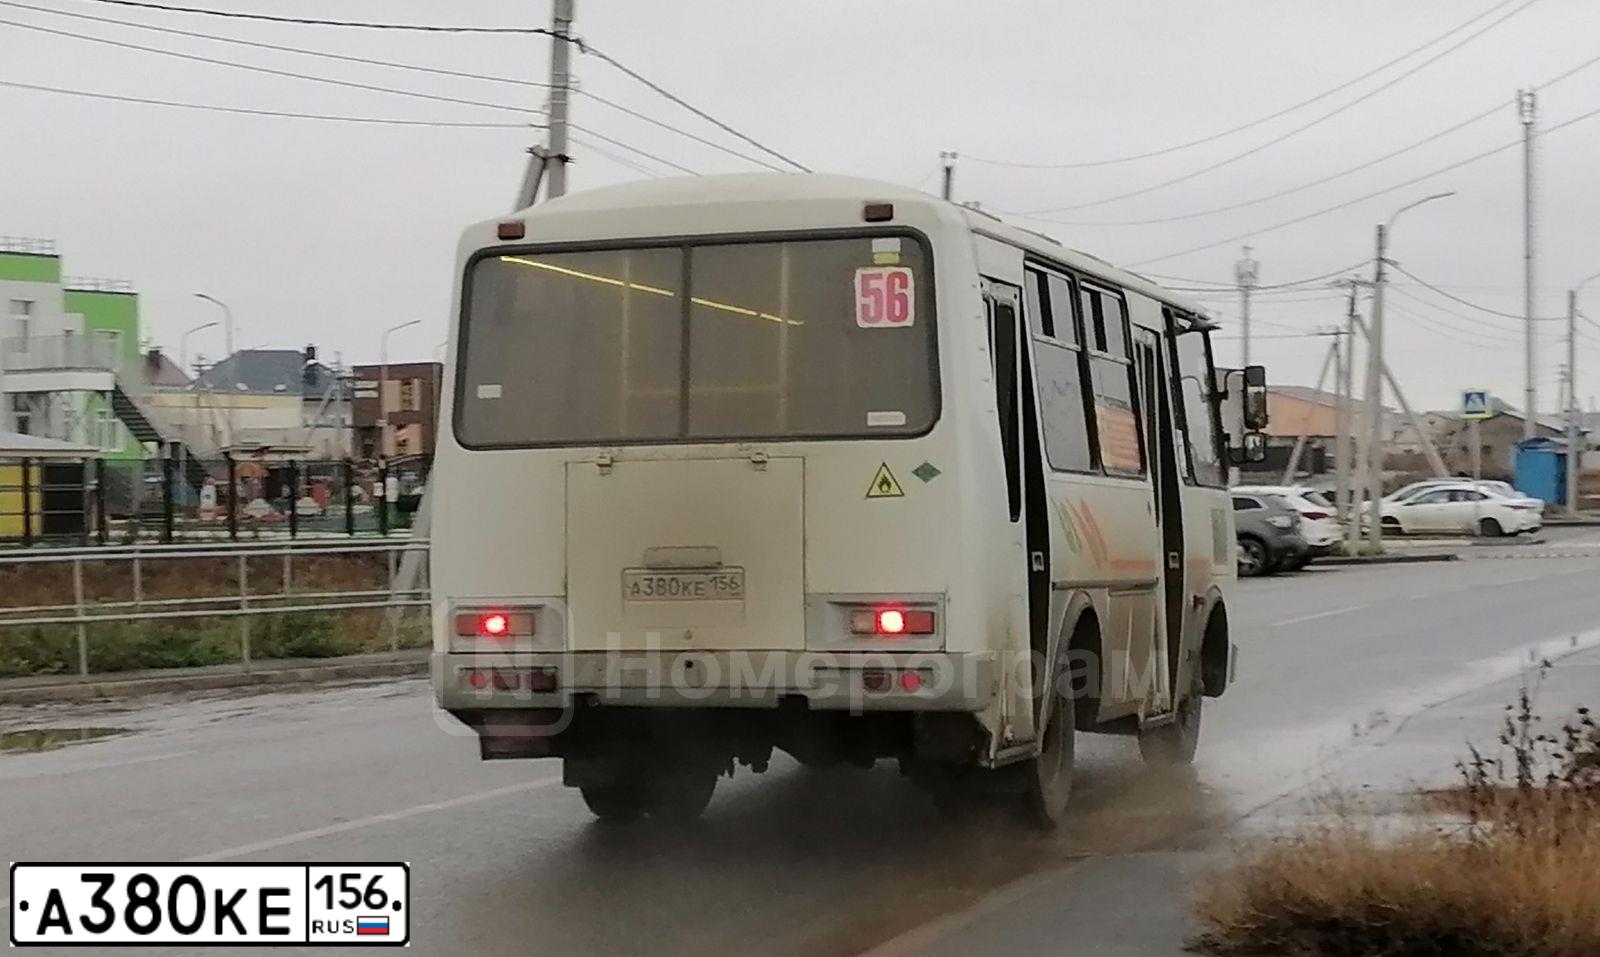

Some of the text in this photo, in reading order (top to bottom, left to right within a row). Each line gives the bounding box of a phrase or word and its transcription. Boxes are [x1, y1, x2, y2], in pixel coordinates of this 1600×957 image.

[861, 271, 908, 323] 56
[630, 576, 741, 596] А380КЕ 156
